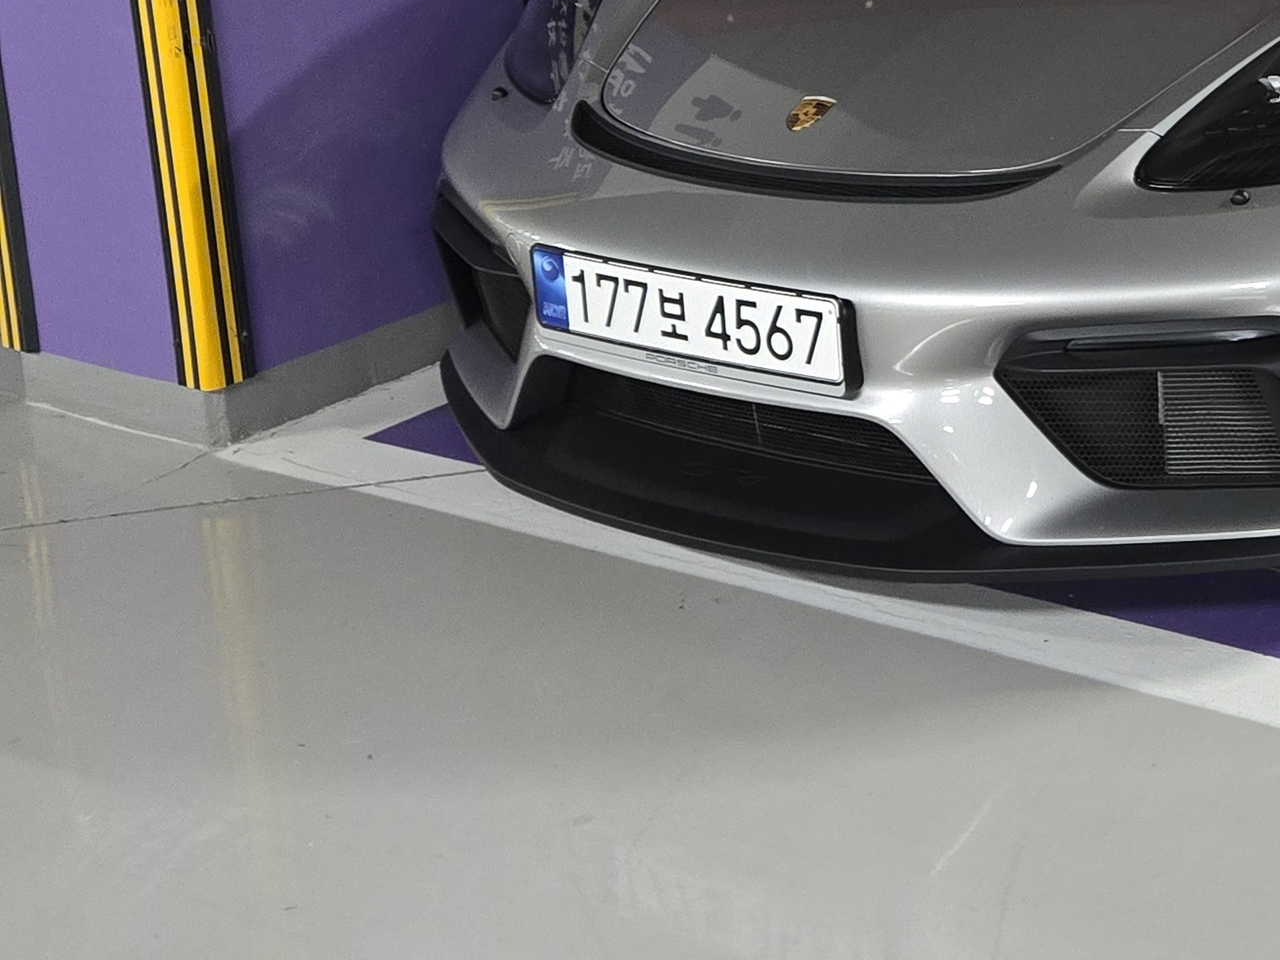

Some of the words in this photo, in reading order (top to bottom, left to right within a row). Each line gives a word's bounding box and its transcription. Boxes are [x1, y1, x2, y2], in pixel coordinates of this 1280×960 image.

[571, 269, 689, 341] 177보
[705, 295, 823, 365] 4567
[645, 353, 718, 373] PORSCHE
